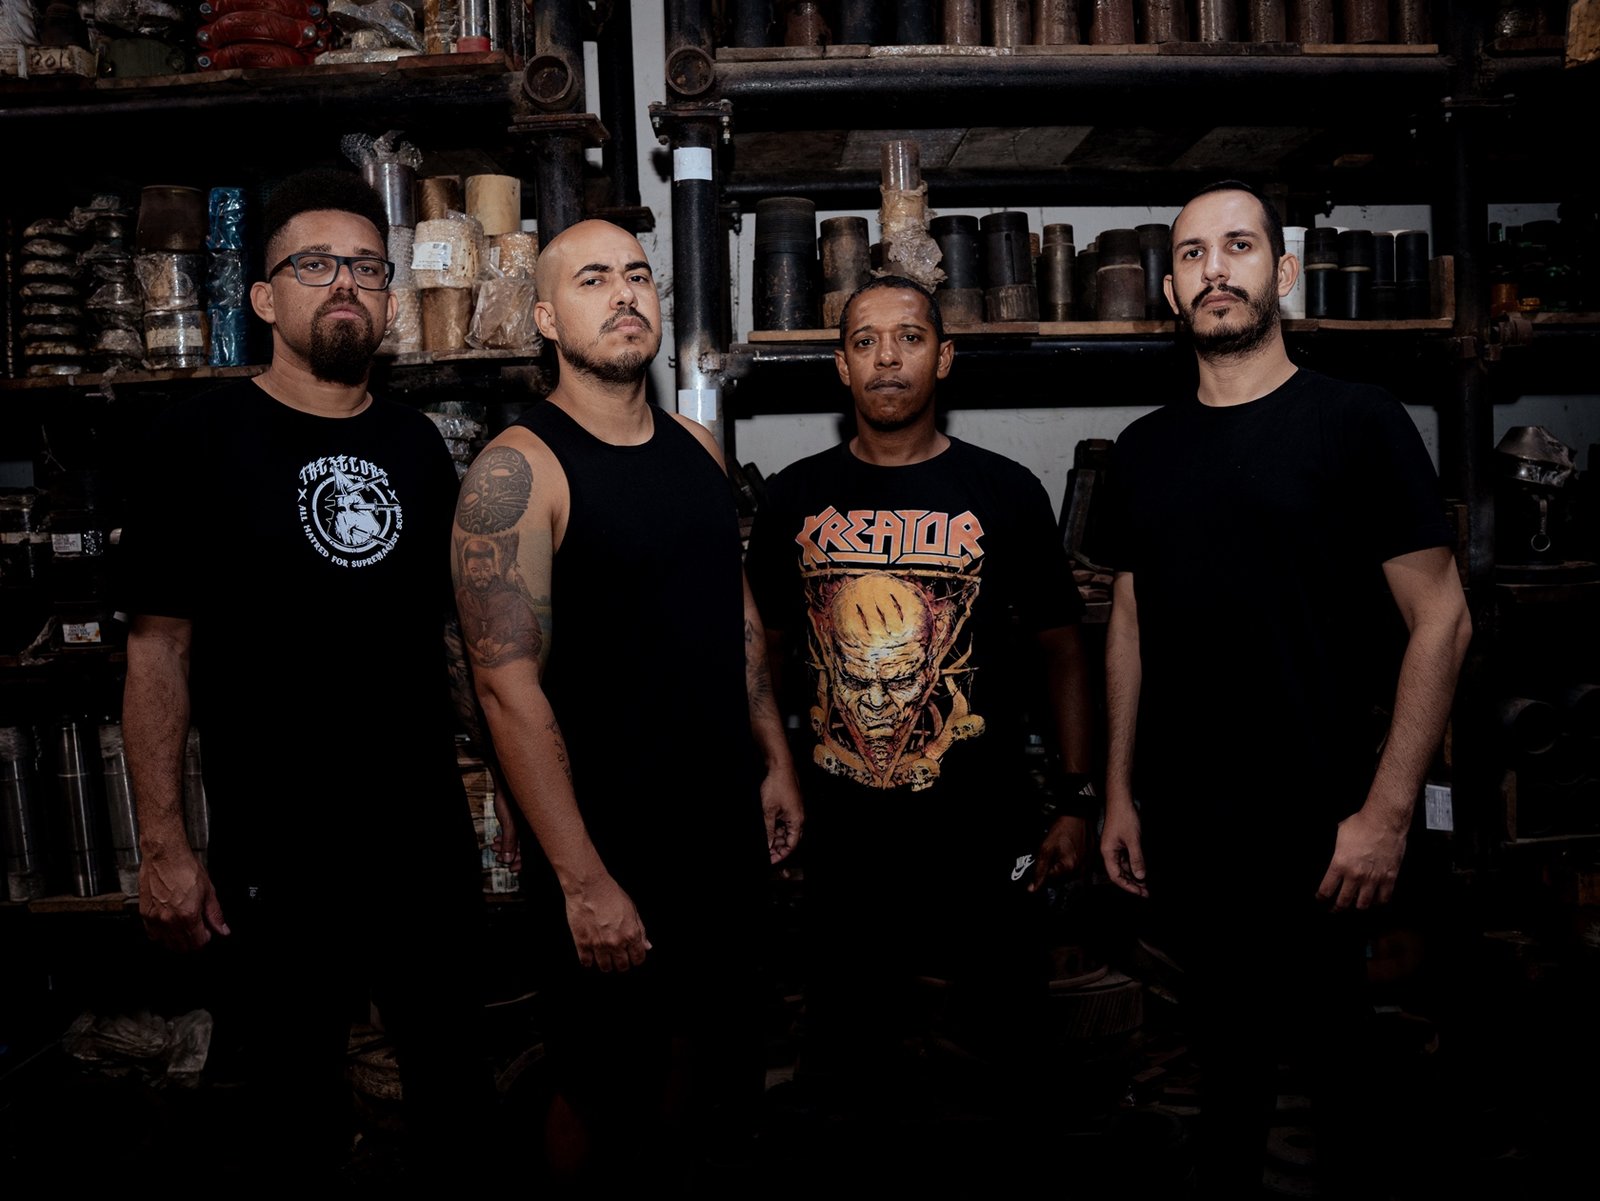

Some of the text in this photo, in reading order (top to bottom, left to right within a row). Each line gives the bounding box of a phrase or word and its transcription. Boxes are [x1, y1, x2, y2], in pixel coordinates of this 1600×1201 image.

[298, 504, 308, 522] ALL
[303, 524, 329, 558] HATRED
[331, 555, 349, 568] FOR
[795, 505, 985, 567] KREATOR
